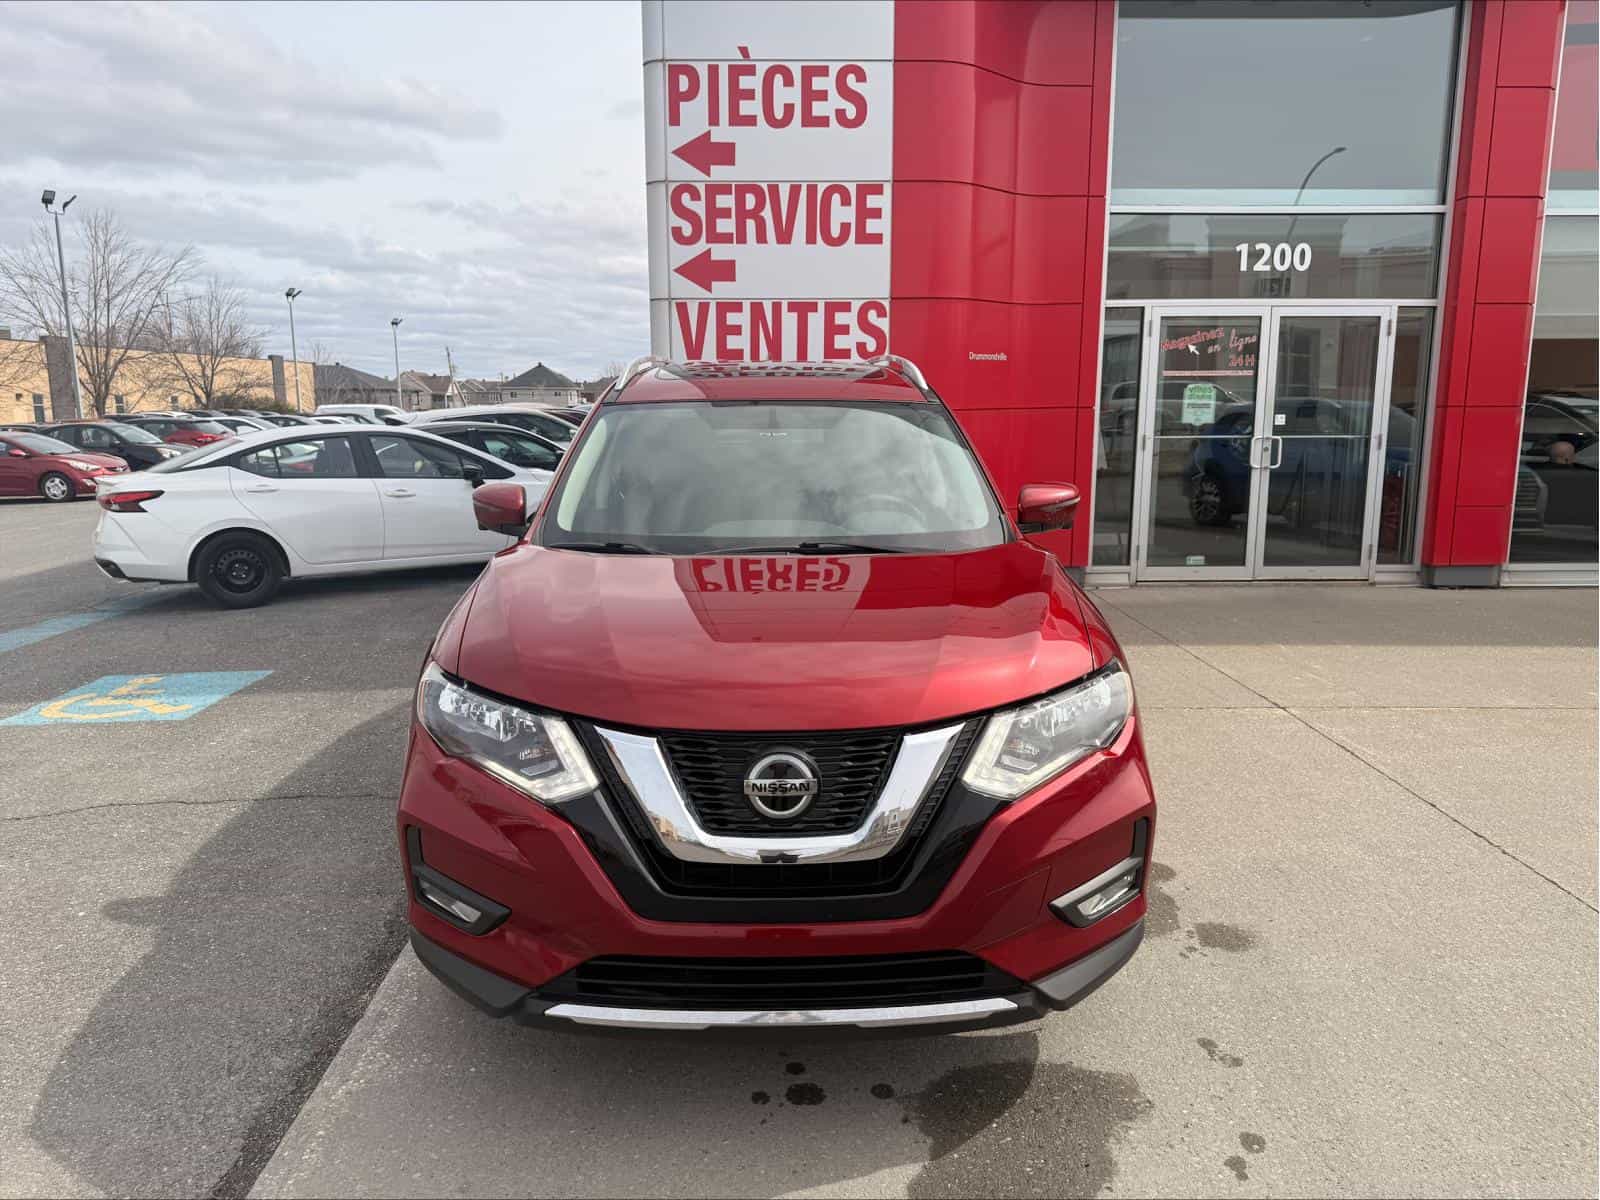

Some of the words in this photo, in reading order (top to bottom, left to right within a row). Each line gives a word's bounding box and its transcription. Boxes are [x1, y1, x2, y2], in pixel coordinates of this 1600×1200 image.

[668, 46, 868, 129] PIÈCES
[670, 183, 884, 247] SERVICE
[1235, 242, 1312, 272] 1200
[675, 301, 888, 362] VENTES
[751, 782, 810, 793] NISSAN
